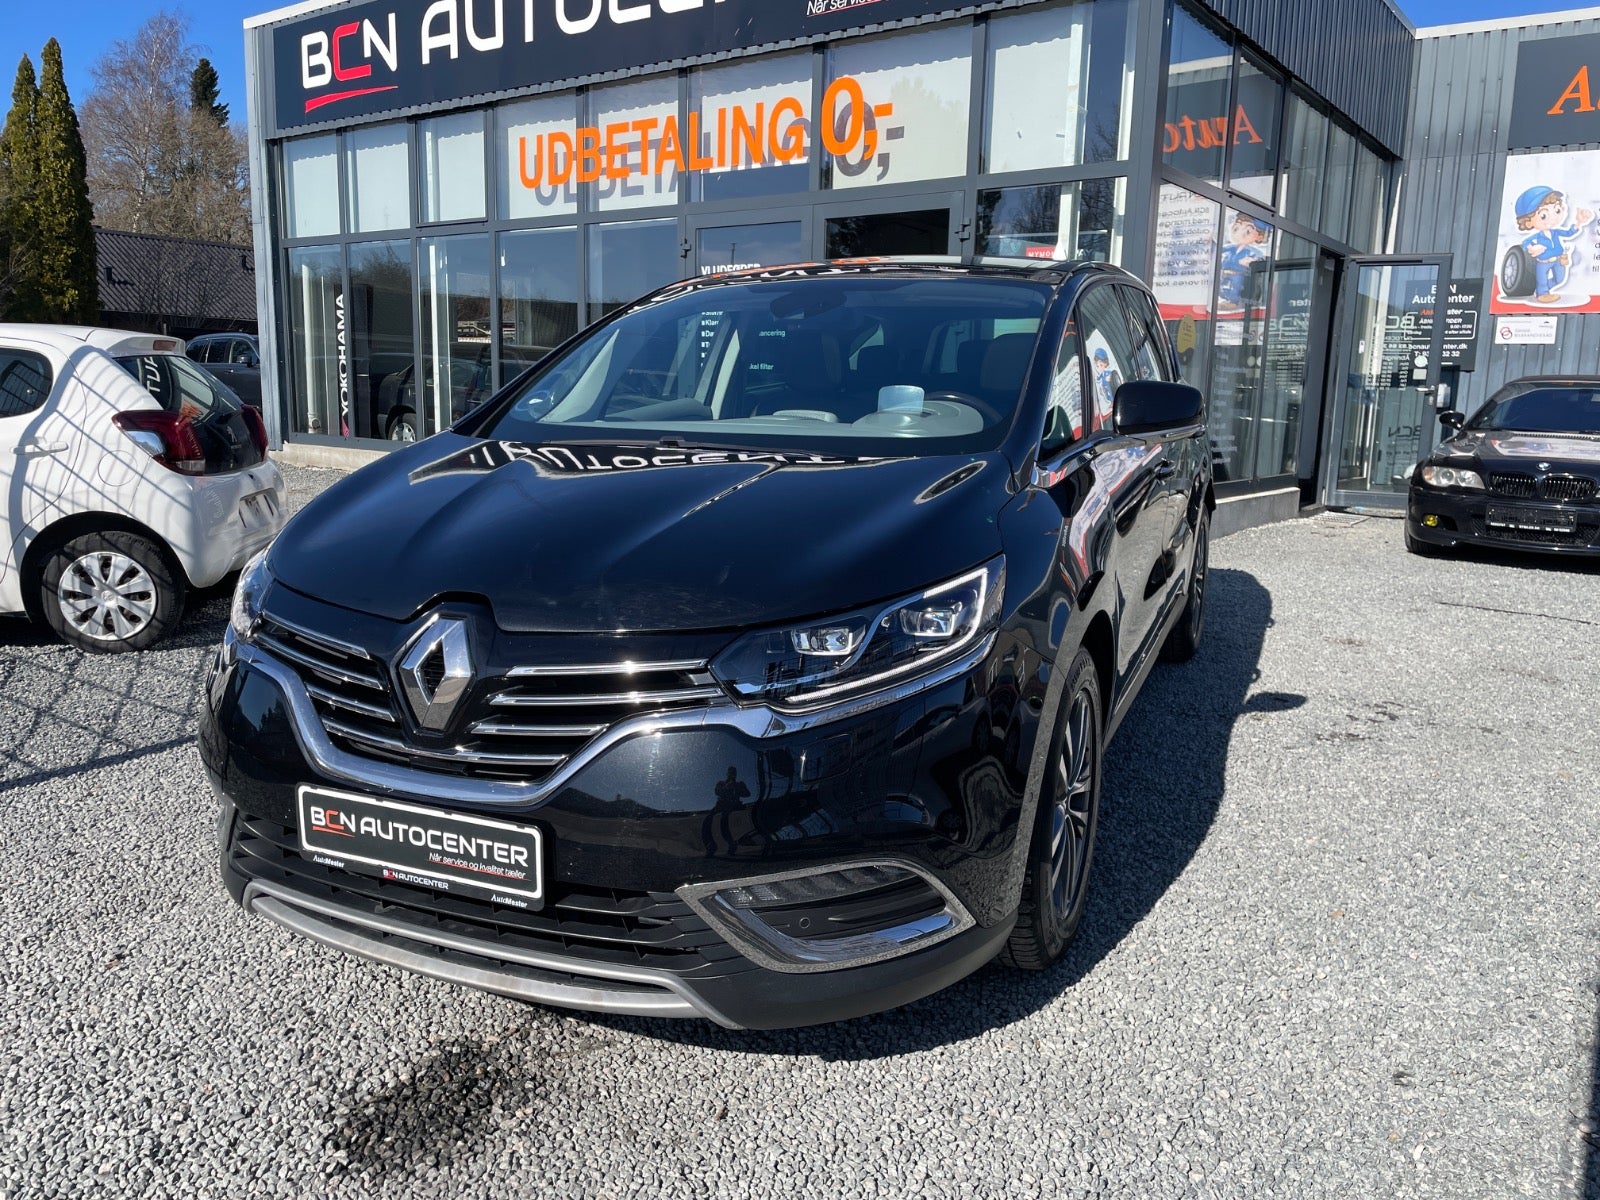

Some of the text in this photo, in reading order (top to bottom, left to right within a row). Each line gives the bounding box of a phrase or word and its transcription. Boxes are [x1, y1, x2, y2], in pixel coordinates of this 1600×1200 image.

[301, 12, 398, 88] BCN
[519, 96, 804, 189] UDBETALING
[335, 293, 349, 417] YOKOHAMA
[310, 806, 529, 868] BCN AUTOCENTER
[313, 854, 345, 868] AutoMester
[383, 868, 450, 890] BCN AUTOCENTER
[428, 852, 527, 879] Når service og kvalitet tæller
[491, 893, 528, 909] AutoMester
